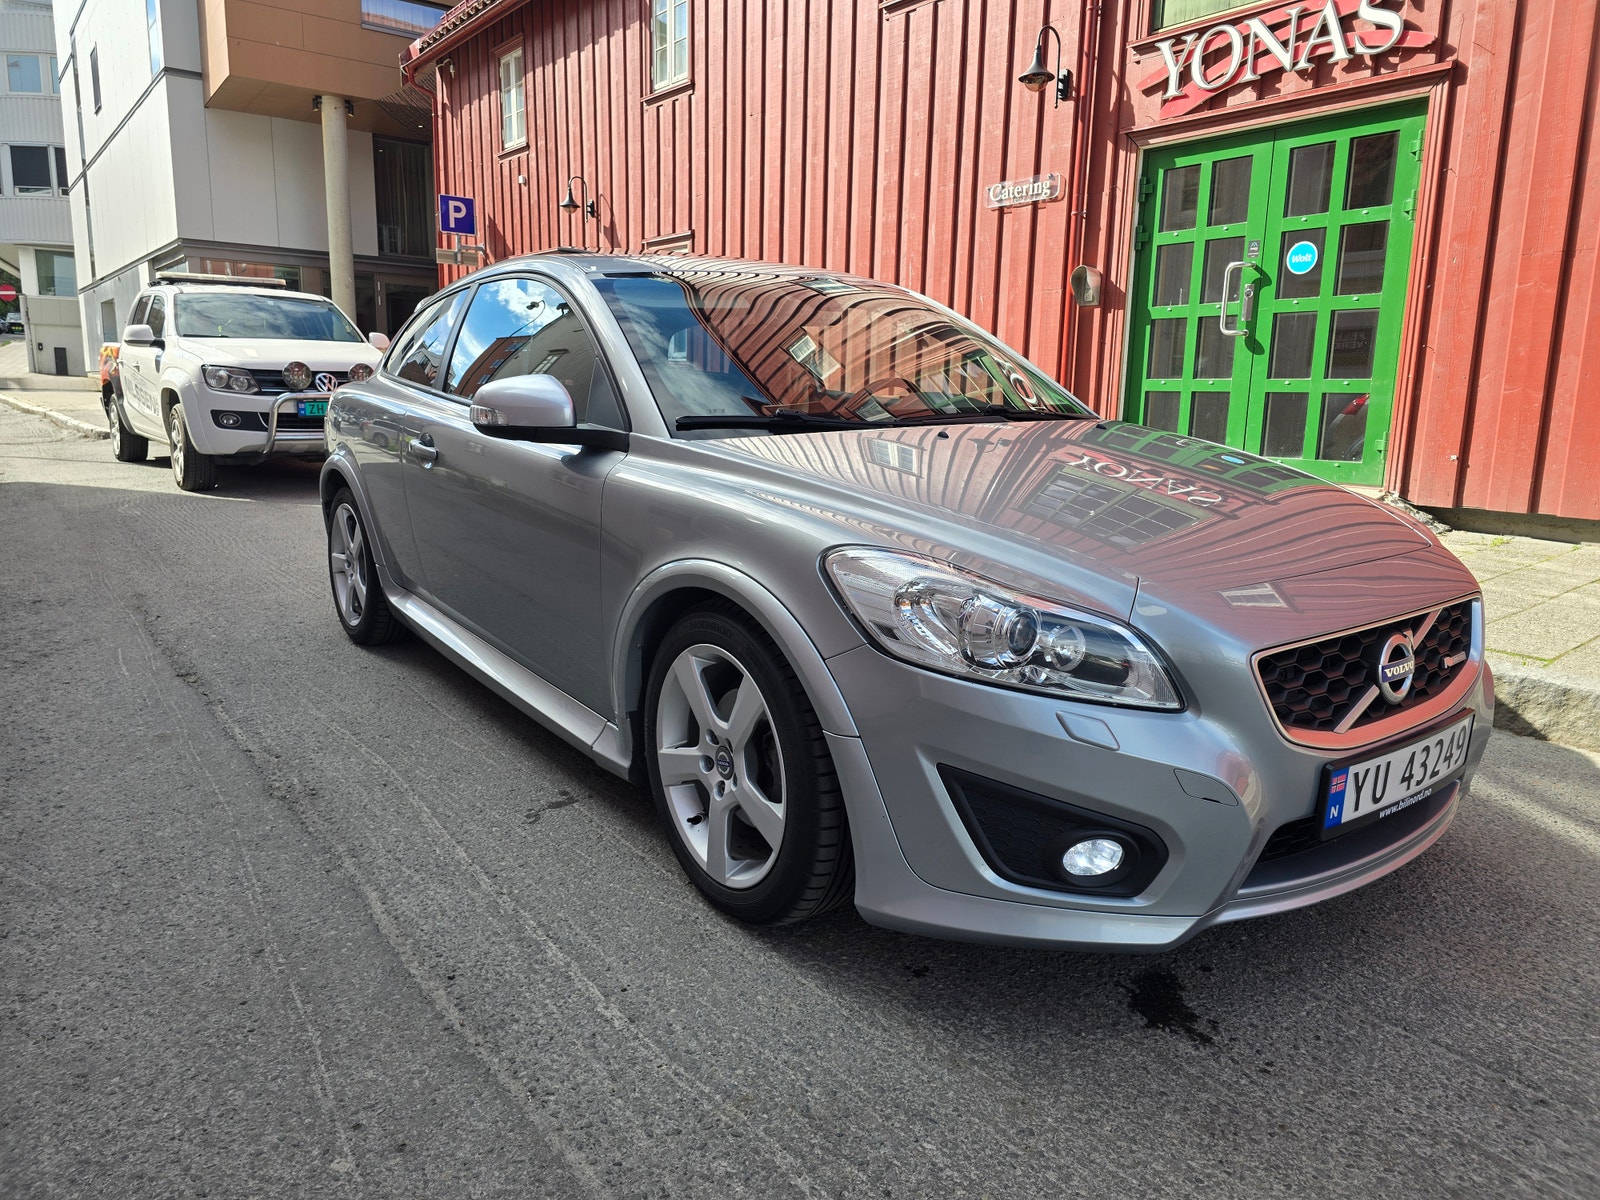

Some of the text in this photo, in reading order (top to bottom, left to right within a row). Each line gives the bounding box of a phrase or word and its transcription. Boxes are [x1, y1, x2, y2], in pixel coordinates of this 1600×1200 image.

[1155, 0, 1404, 99] YONAS
[989, 178, 1051, 201] Catering
[448, 200, 467, 229] P
[1291, 253, 1313, 263] Wolt
[309, 403, 325, 415] ZH
[1384, 660, 1414, 677] VOLVO
[1353, 725, 1467, 812] YU 43249
[1330, 804, 1339, 819] N
